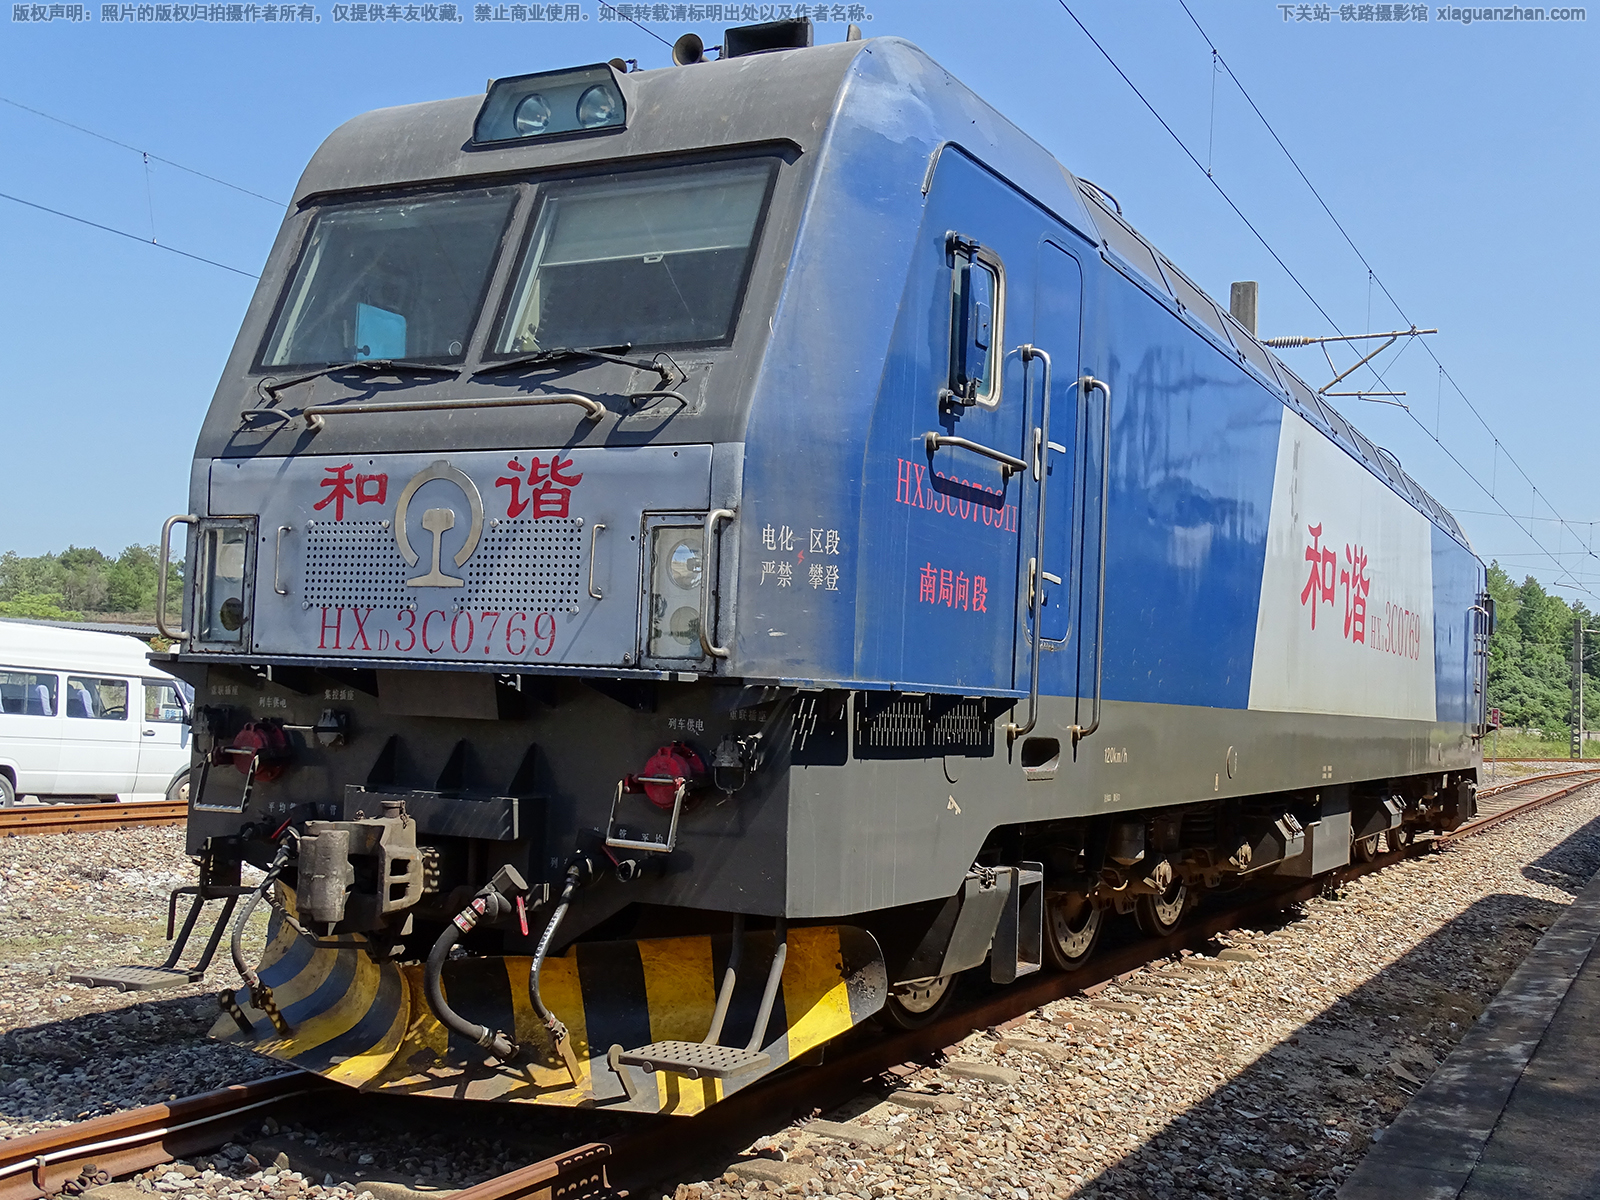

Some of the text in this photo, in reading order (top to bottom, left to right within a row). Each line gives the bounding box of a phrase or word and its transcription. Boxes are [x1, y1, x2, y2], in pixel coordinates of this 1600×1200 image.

[313, 455, 583, 521] 和 谐
[919, 562, 988, 613] 南局向段
[1300, 522, 1370, 645] 和谐
[317, 607, 557, 656] HXD3C0769
[668, 717, 704, 732] 列车供电
